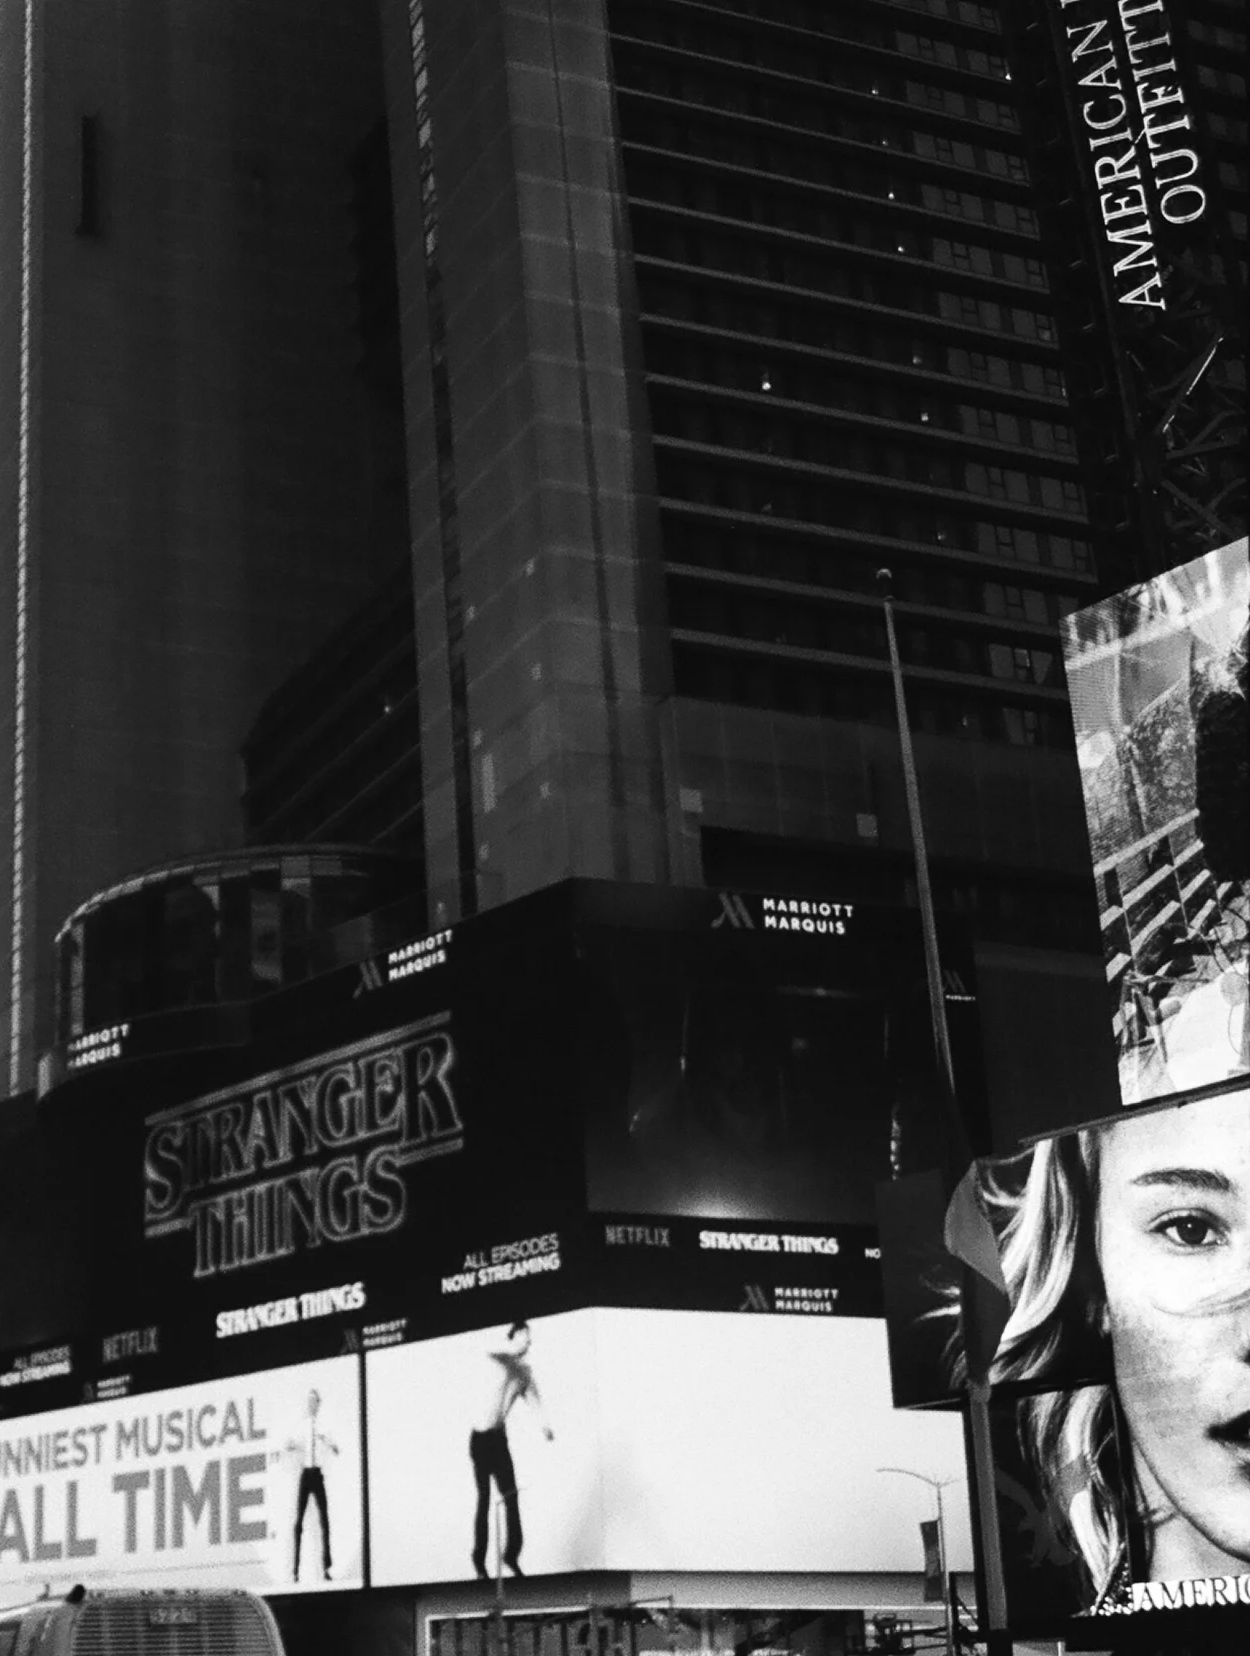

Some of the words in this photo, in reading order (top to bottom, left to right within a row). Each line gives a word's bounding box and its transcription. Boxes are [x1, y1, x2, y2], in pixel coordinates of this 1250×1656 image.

[1118, 0, 1206, 224] OUTFITT
[1066, 19, 1166, 310] AMERICAN
[763, 898, 853, 918] MARRIOTT
[764, 915, 846, 935] MARQUIS
[388, 929, 453, 965] MARRIOTT
[388, 949, 447, 982] MARQUIS
[145, 1031, 464, 1220] STRANGER
[190, 1145, 407, 1278] THINGS
[463, 1251, 489, 1270] ALL
[491, 1232, 559, 1264] EPISODES
[605, 1225, 671, 1247] NETFLIX
[699, 1230, 780, 1252] STRANGER
[781, 1235, 839, 1255] THINGS
[441, 1271, 476, 1294] NOW
[478, 1252, 561, 1286] STREAMING
[216, 1296, 299, 1338] STRANGER
[299, 1281, 367, 1320] THINGS
[774, 1286, 839, 1300] MARRIOTT
[774, 1299, 833, 1313] MARQUIS
[102, 1325, 157, 1362] NETFLIX
[114, 1397, 267, 1459] MUSICAL
